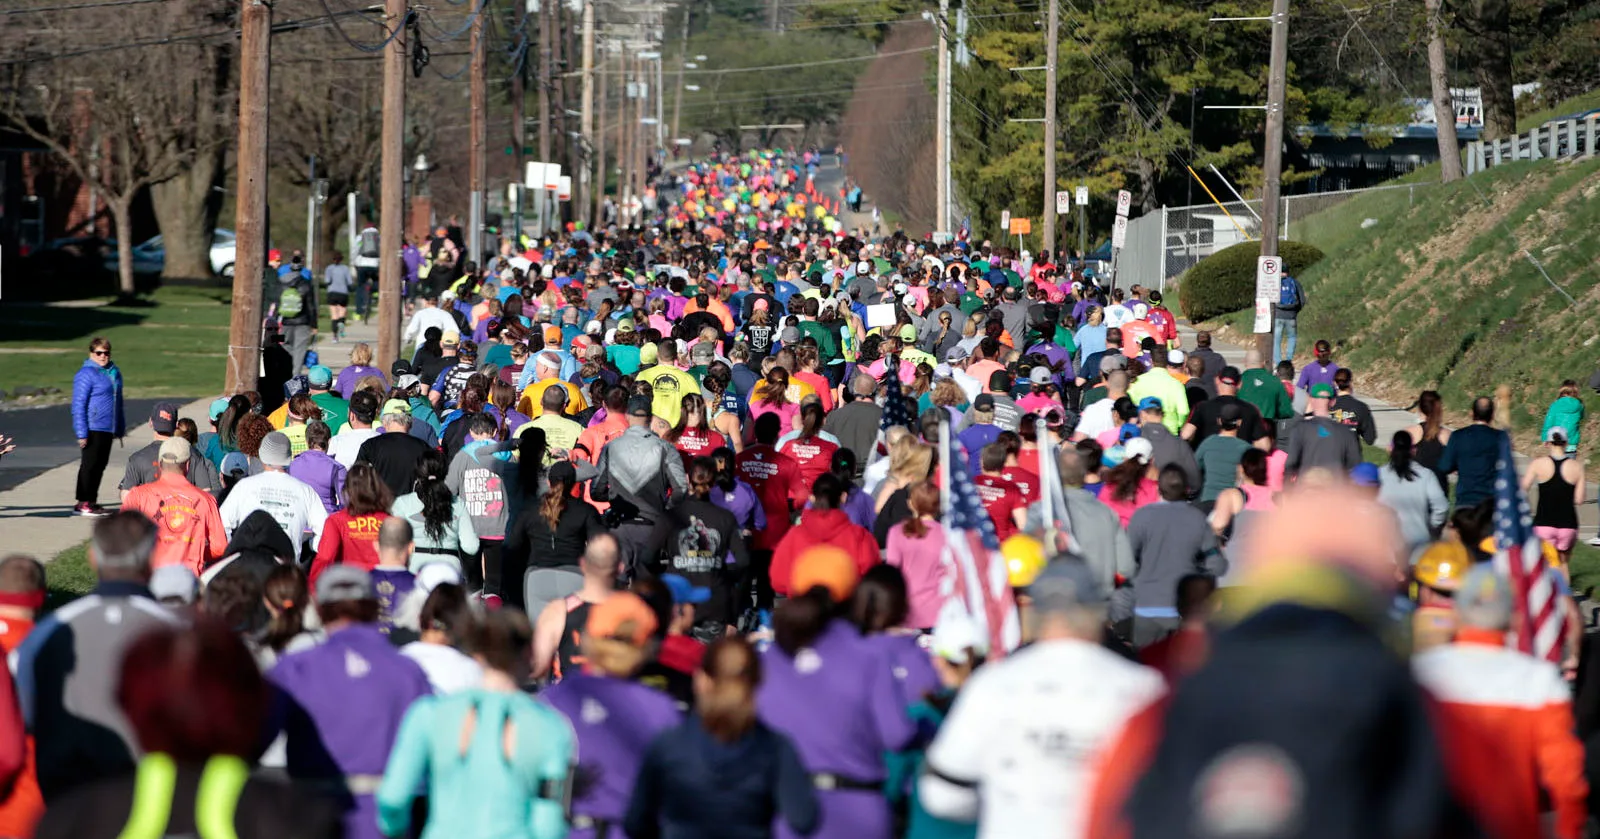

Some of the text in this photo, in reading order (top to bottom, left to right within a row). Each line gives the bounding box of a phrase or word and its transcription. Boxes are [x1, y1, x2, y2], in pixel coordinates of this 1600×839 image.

[742, 460, 778, 470] ENRICHING
[741, 466, 779, 476] VETERANS
[749, 472, 769, 480] LIVES
[493, 490, 503, 501] TO
[356, 516, 379, 532] PR
